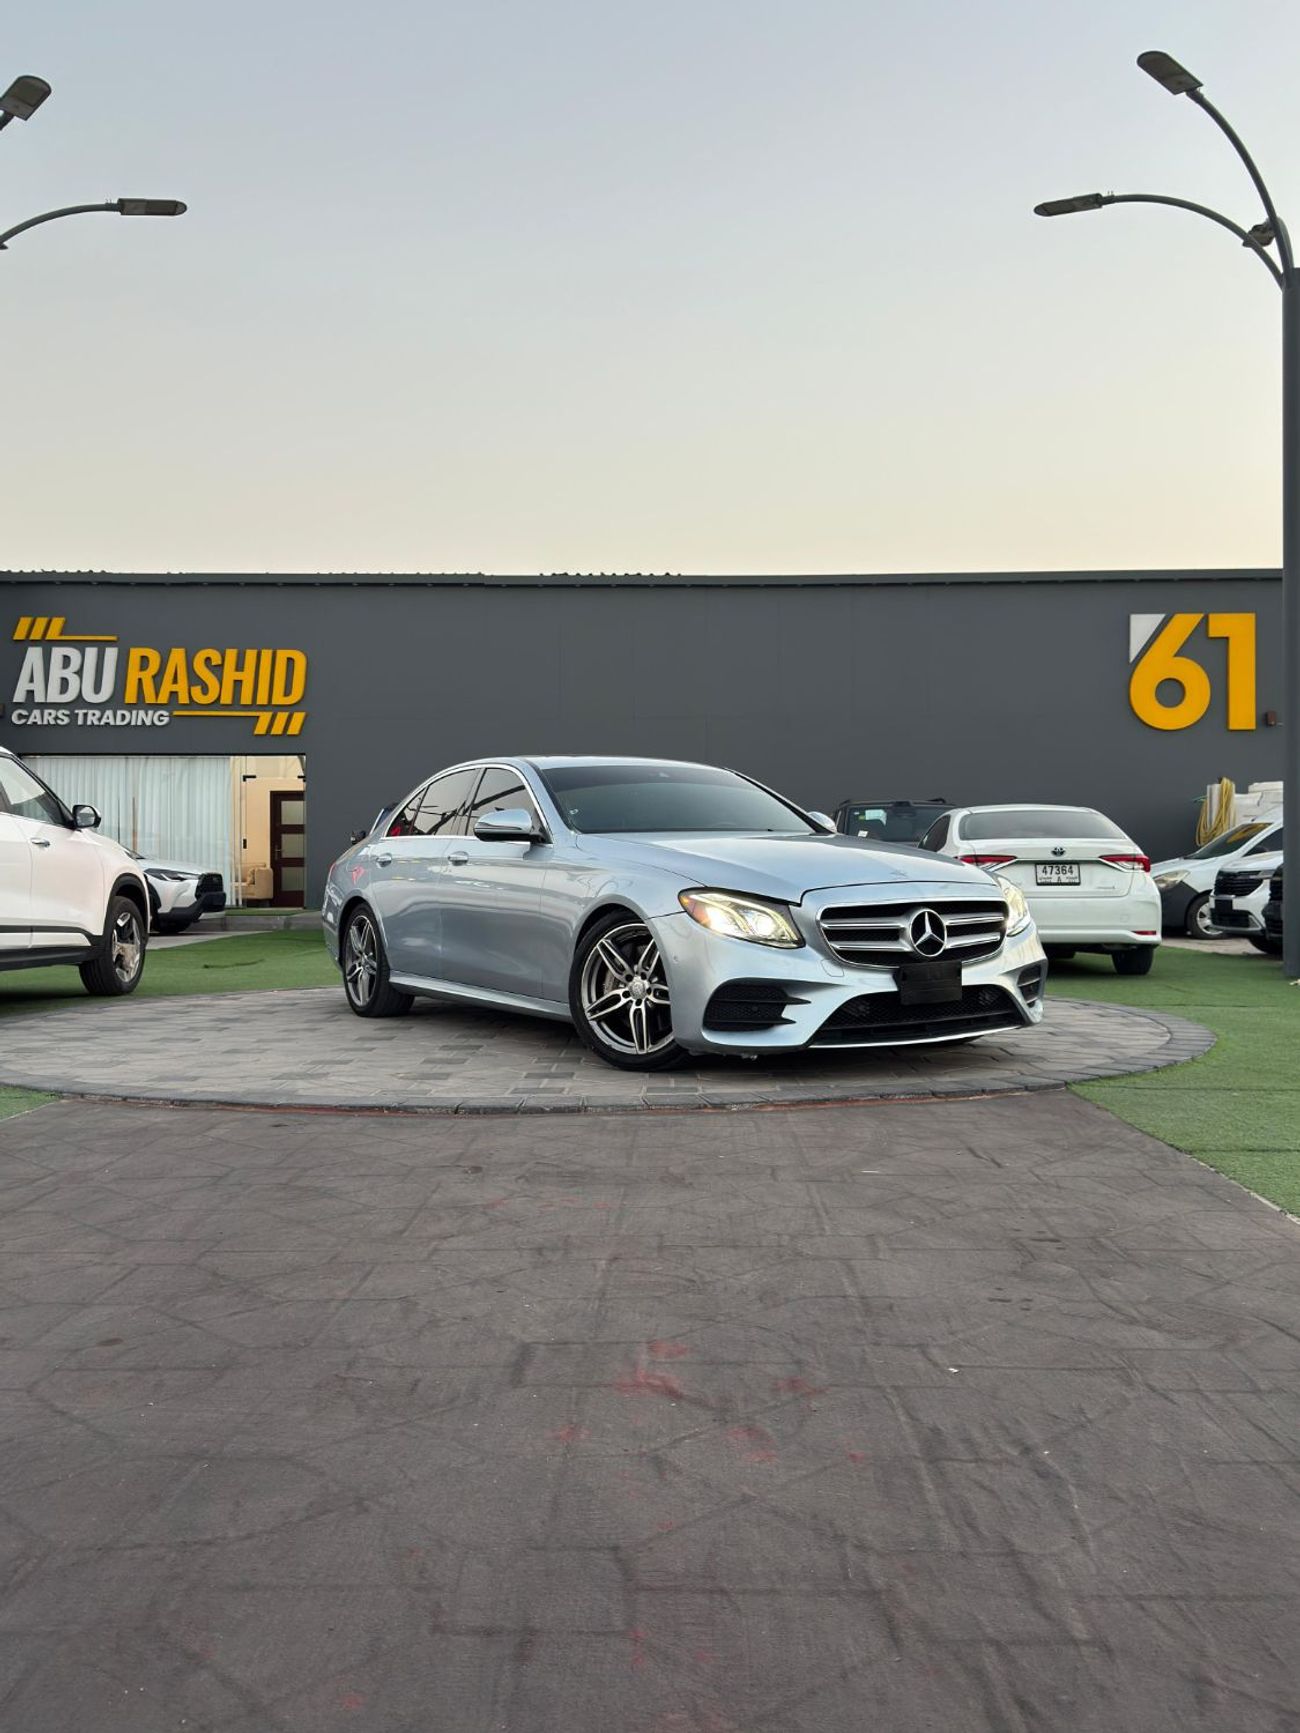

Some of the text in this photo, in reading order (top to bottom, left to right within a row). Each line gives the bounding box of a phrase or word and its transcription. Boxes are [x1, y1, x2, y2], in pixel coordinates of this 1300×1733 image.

[12, 646, 308, 706] ABU RASHID
[1129, 612, 1257, 731] 61
[11, 709, 170, 726] CARS TRADING
[1042, 865, 1074, 875] 47364
